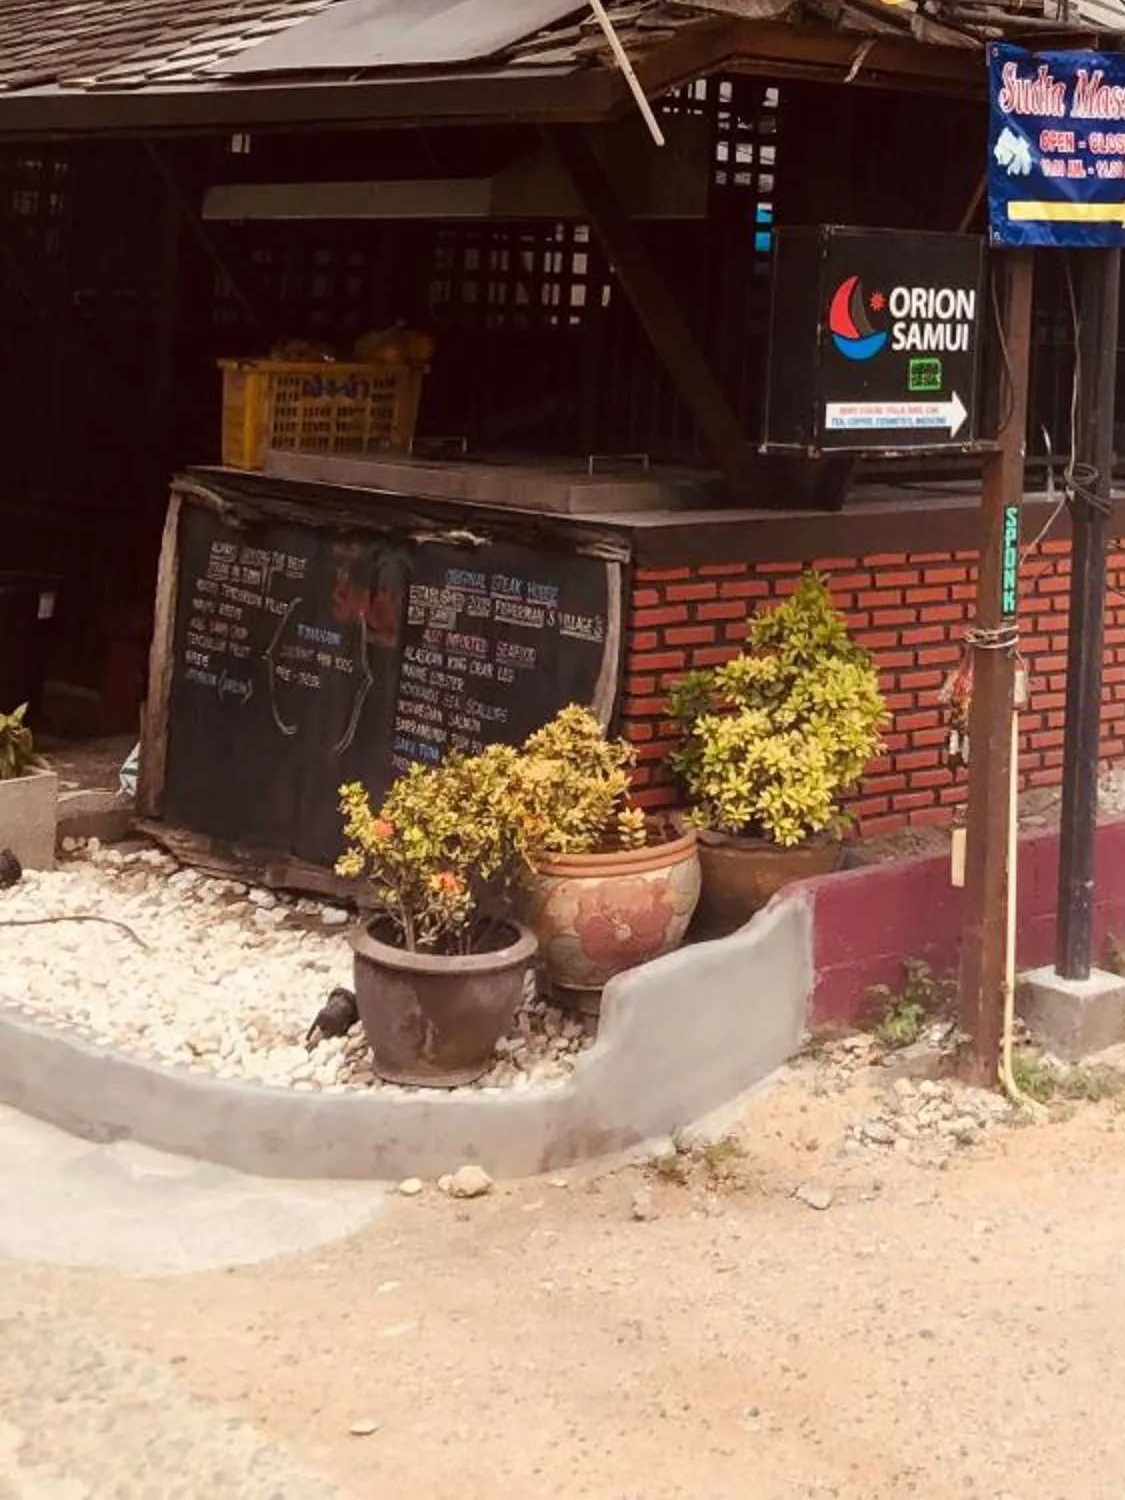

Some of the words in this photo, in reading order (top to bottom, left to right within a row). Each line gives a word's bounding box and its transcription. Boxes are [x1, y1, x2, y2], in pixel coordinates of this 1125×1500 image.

[1040, 129, 1075, 152] OPEN
[888, 286, 976, 320] ORION
[891, 323, 969, 351] SAMUI
